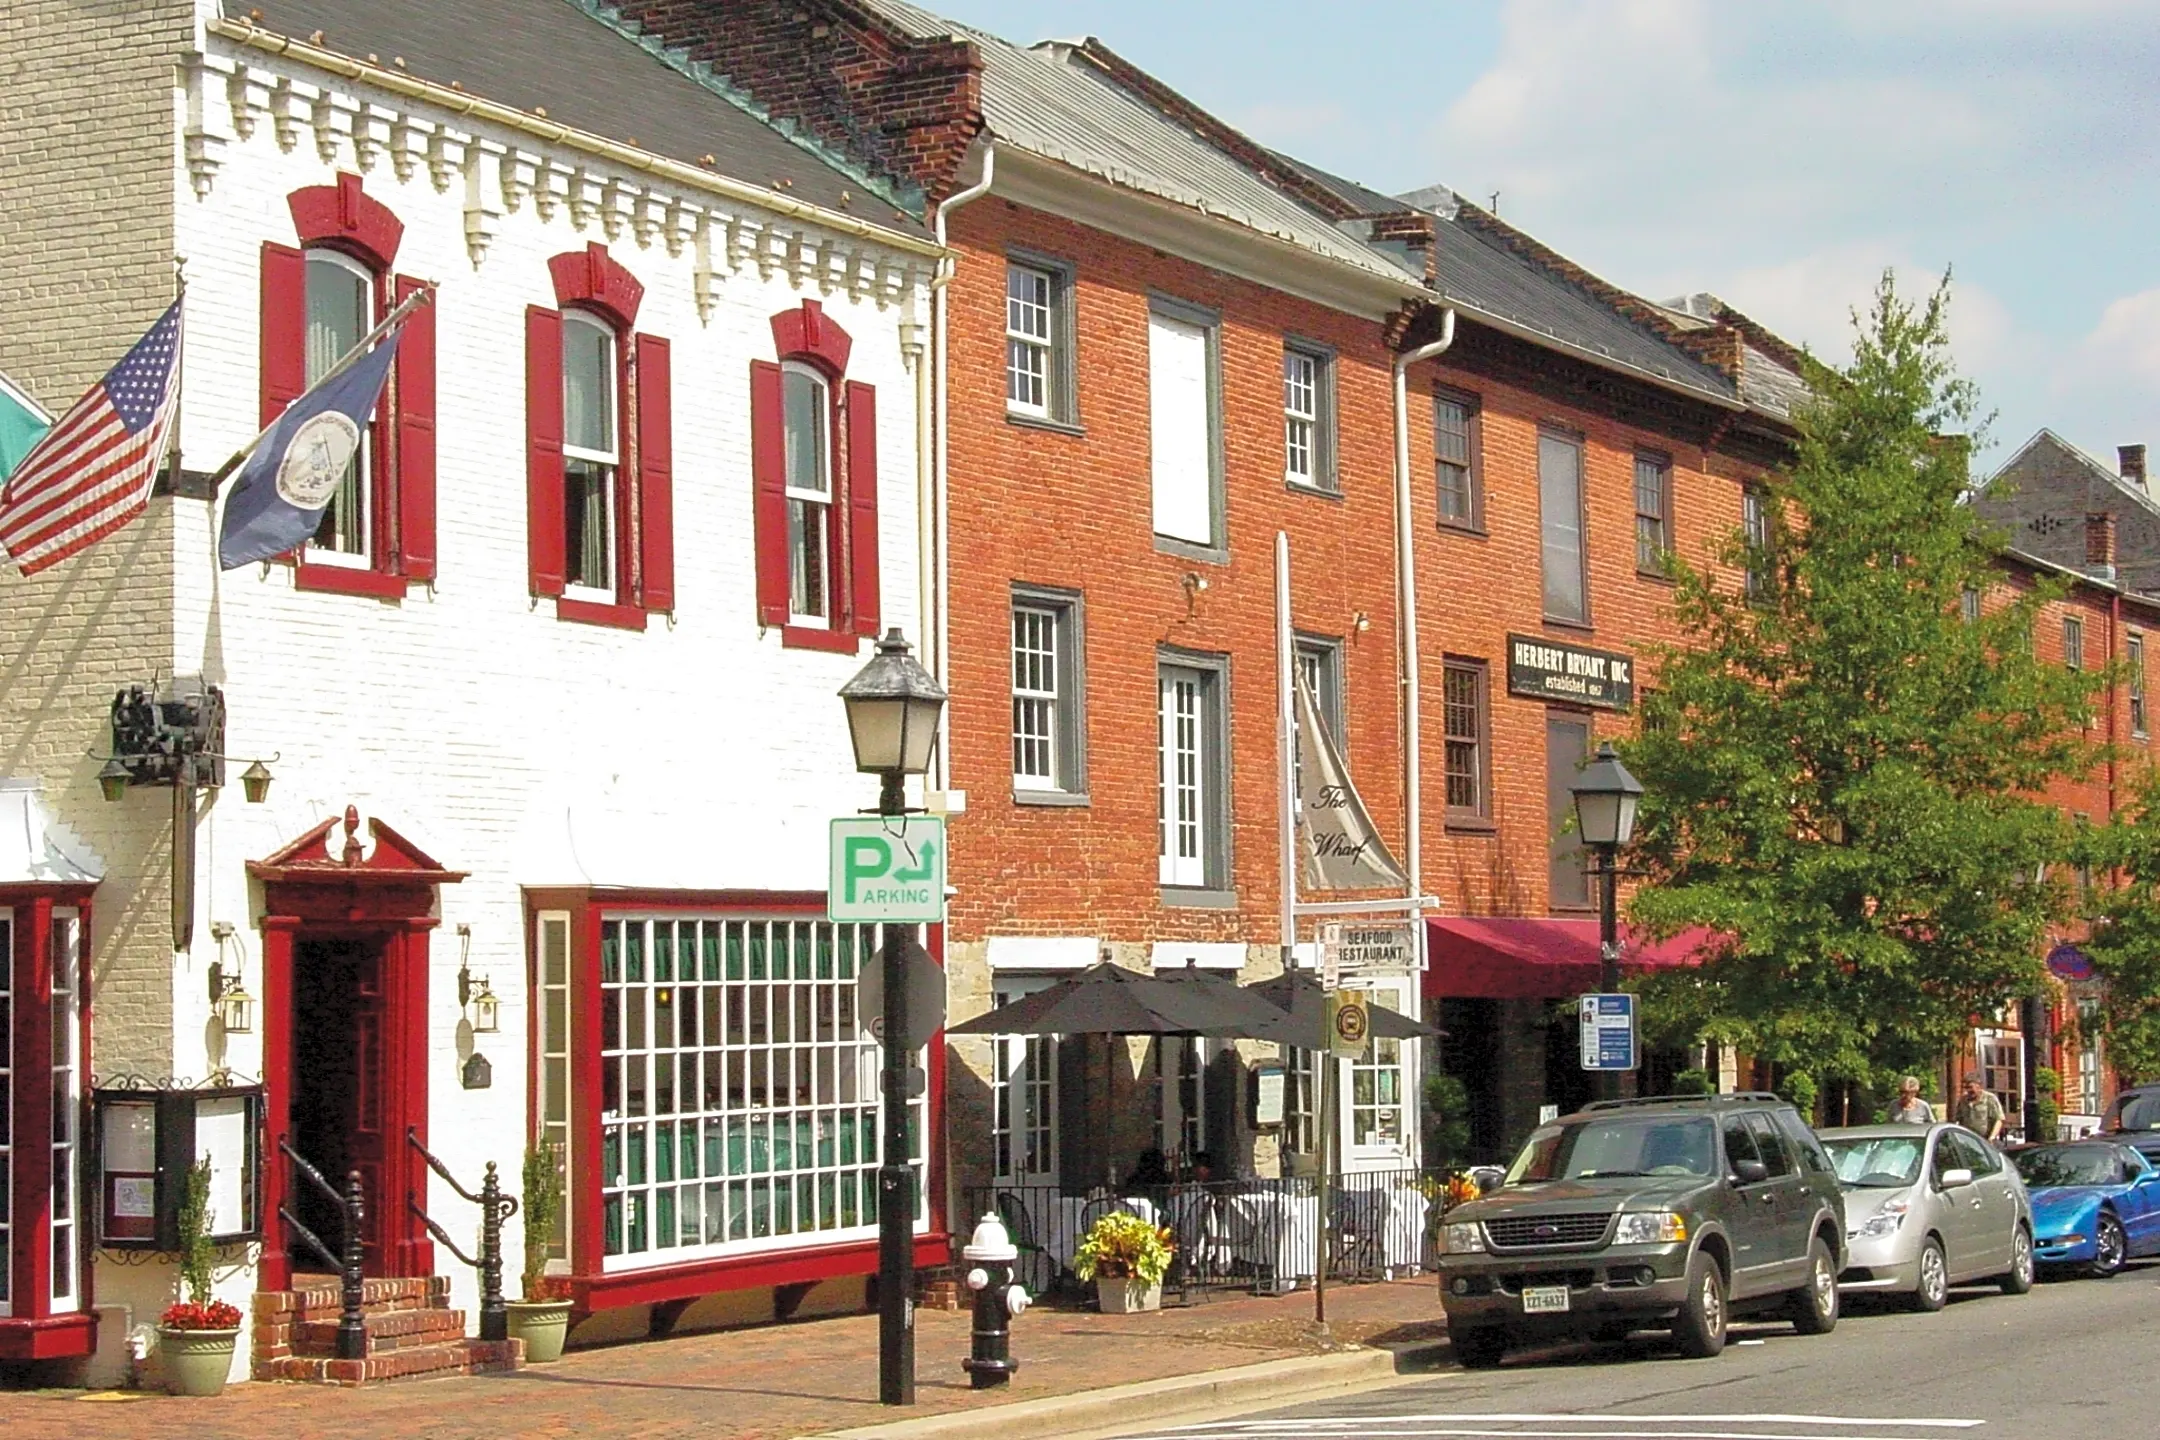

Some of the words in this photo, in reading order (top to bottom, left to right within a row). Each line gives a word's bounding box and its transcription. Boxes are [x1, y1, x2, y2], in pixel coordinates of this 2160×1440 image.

[1515, 642, 1564, 673] HERBERT
[1545, 676, 1586, 693] established
[1311, 784, 1348, 809] The
[1313, 832, 1373, 866] Wharf
[845, 836, 930, 904] PARKING
[1347, 930, 1393, 946] SEAFOOD
